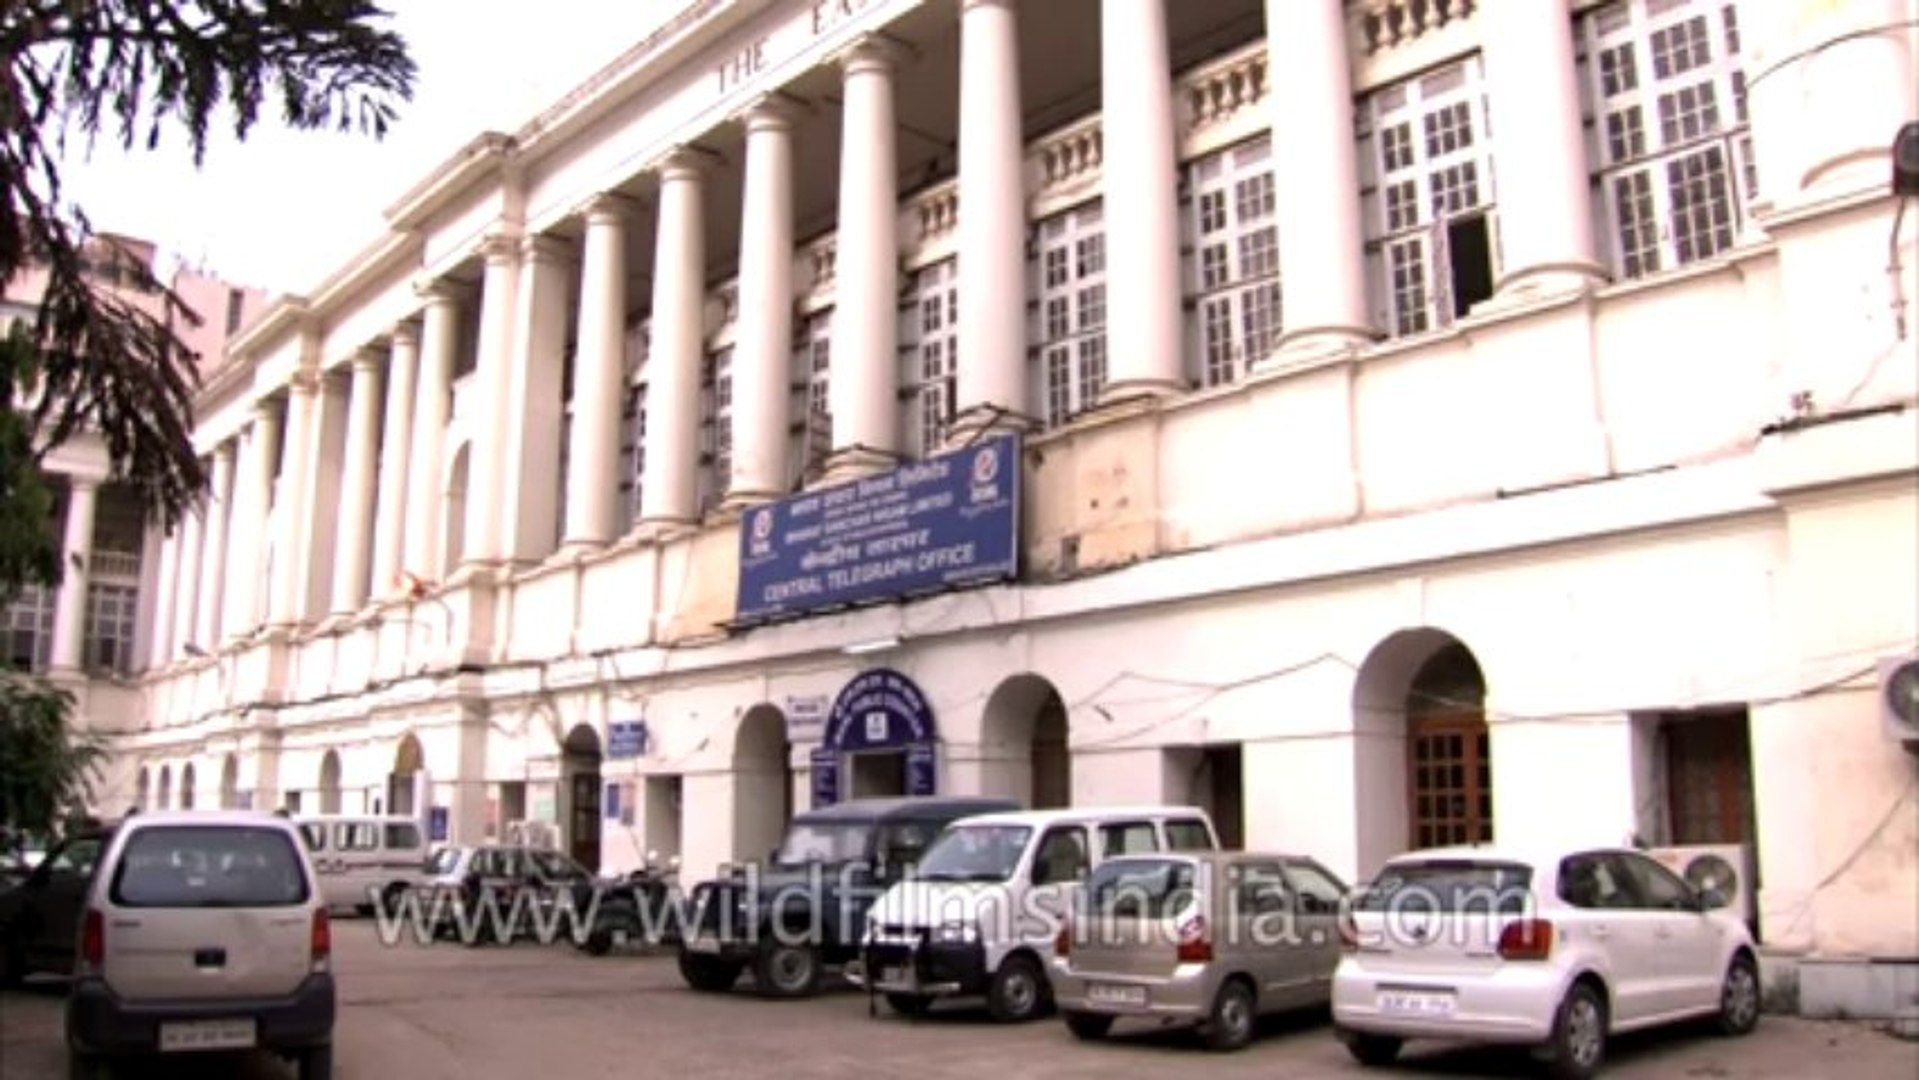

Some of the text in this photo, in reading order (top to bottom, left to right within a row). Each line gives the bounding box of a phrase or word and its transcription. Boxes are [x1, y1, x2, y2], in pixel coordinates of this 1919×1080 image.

[717, 38, 766, 94] THE
[764, 573, 823, 602] CENTRAL
[828, 559, 914, 589] TELEGRAPH
[917, 544, 975, 571] OFFICE
